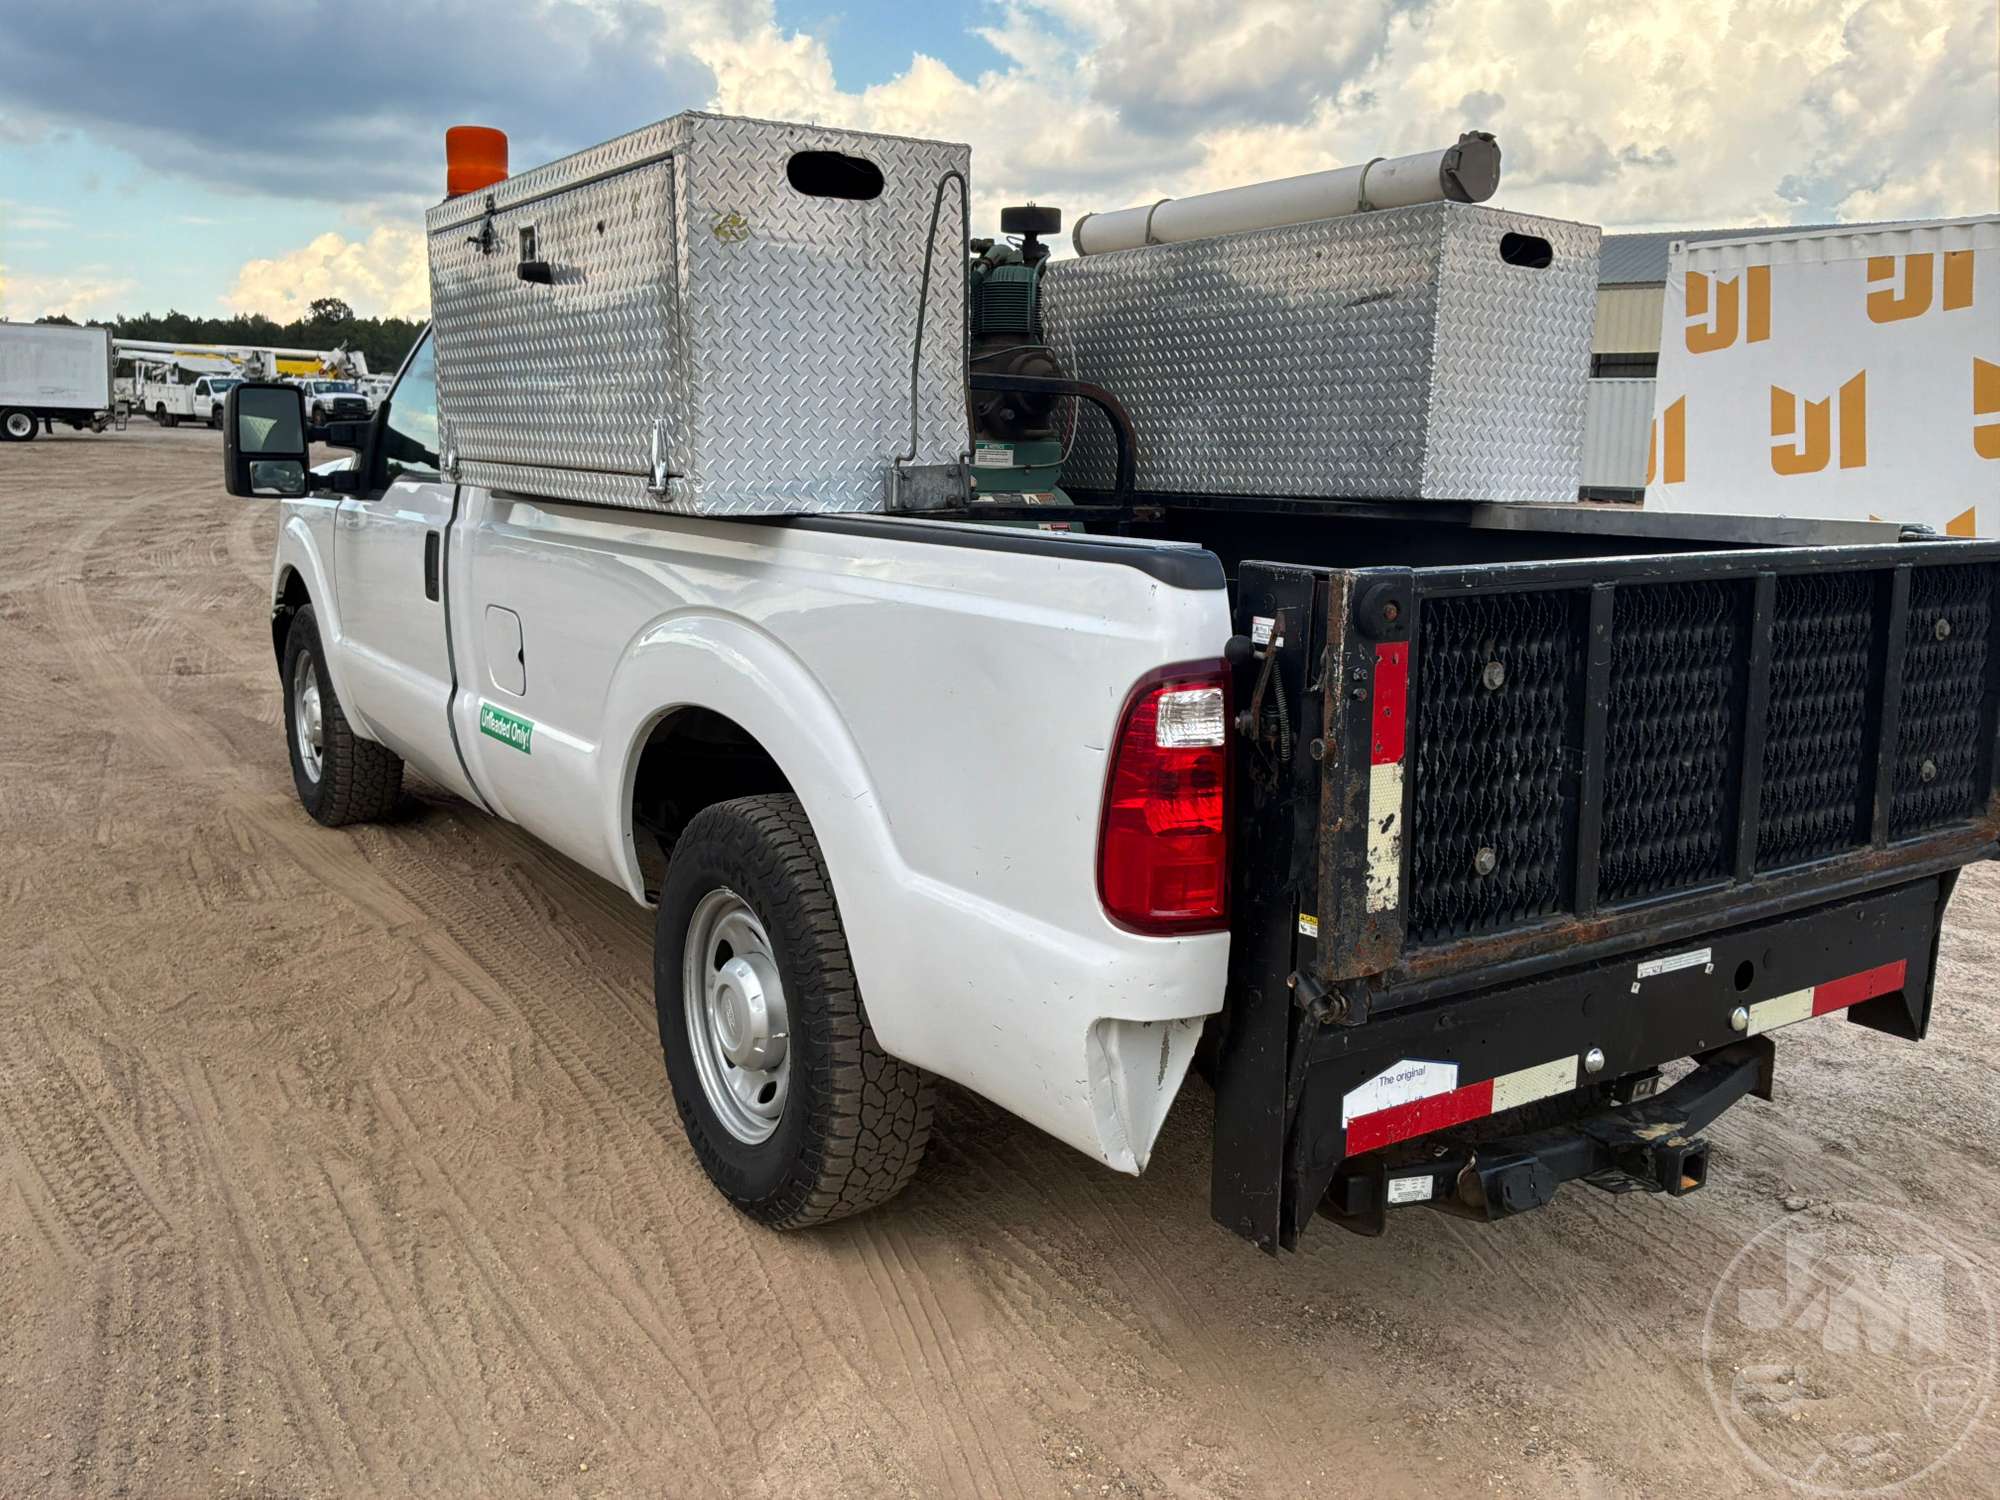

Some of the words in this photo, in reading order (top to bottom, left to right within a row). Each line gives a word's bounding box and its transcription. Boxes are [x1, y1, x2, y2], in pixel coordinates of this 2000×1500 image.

[481, 709, 511, 738] Unleaded
[511, 722, 530, 750] Only!
[1379, 1076, 1394, 1087] The
[1396, 1065, 1426, 1083] original
